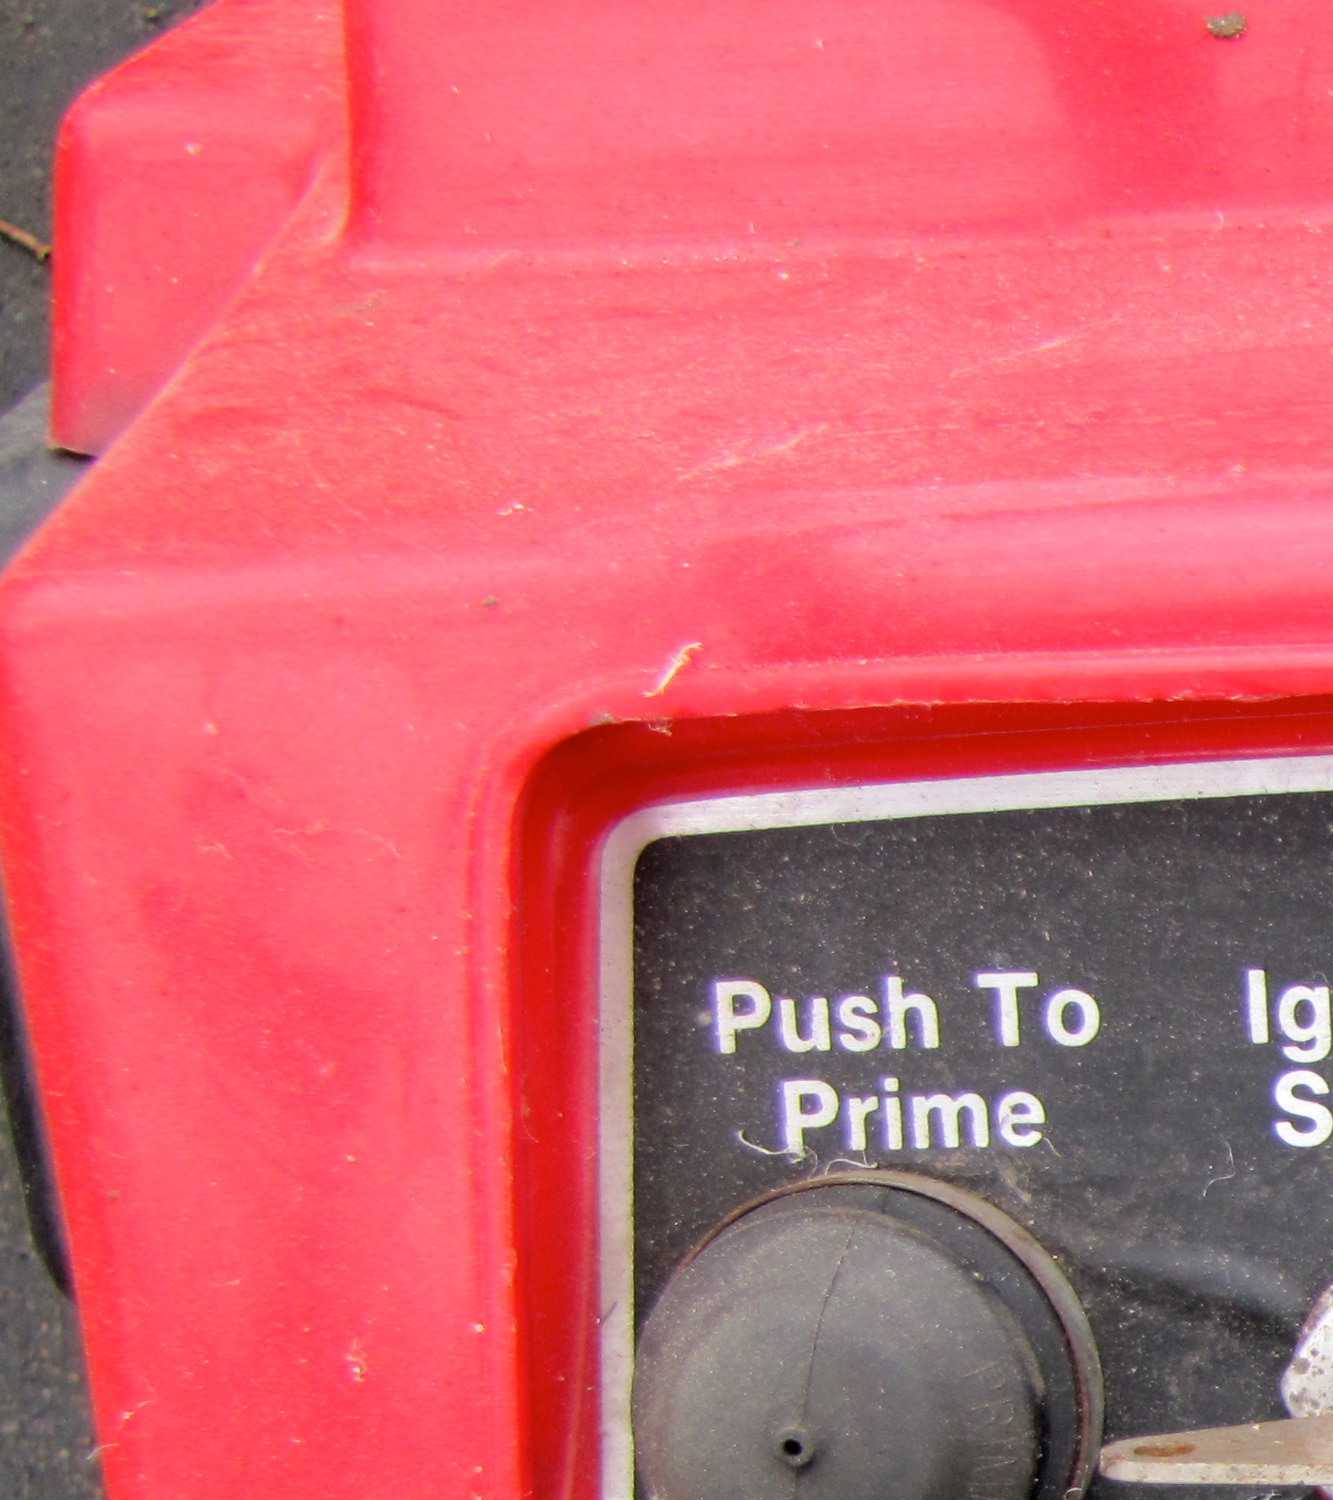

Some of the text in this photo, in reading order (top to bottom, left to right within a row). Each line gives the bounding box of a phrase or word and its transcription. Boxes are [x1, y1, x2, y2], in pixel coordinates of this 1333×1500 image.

[714, 972, 1100, 1055] Push To
[780, 1077, 1046, 1152] Prime
